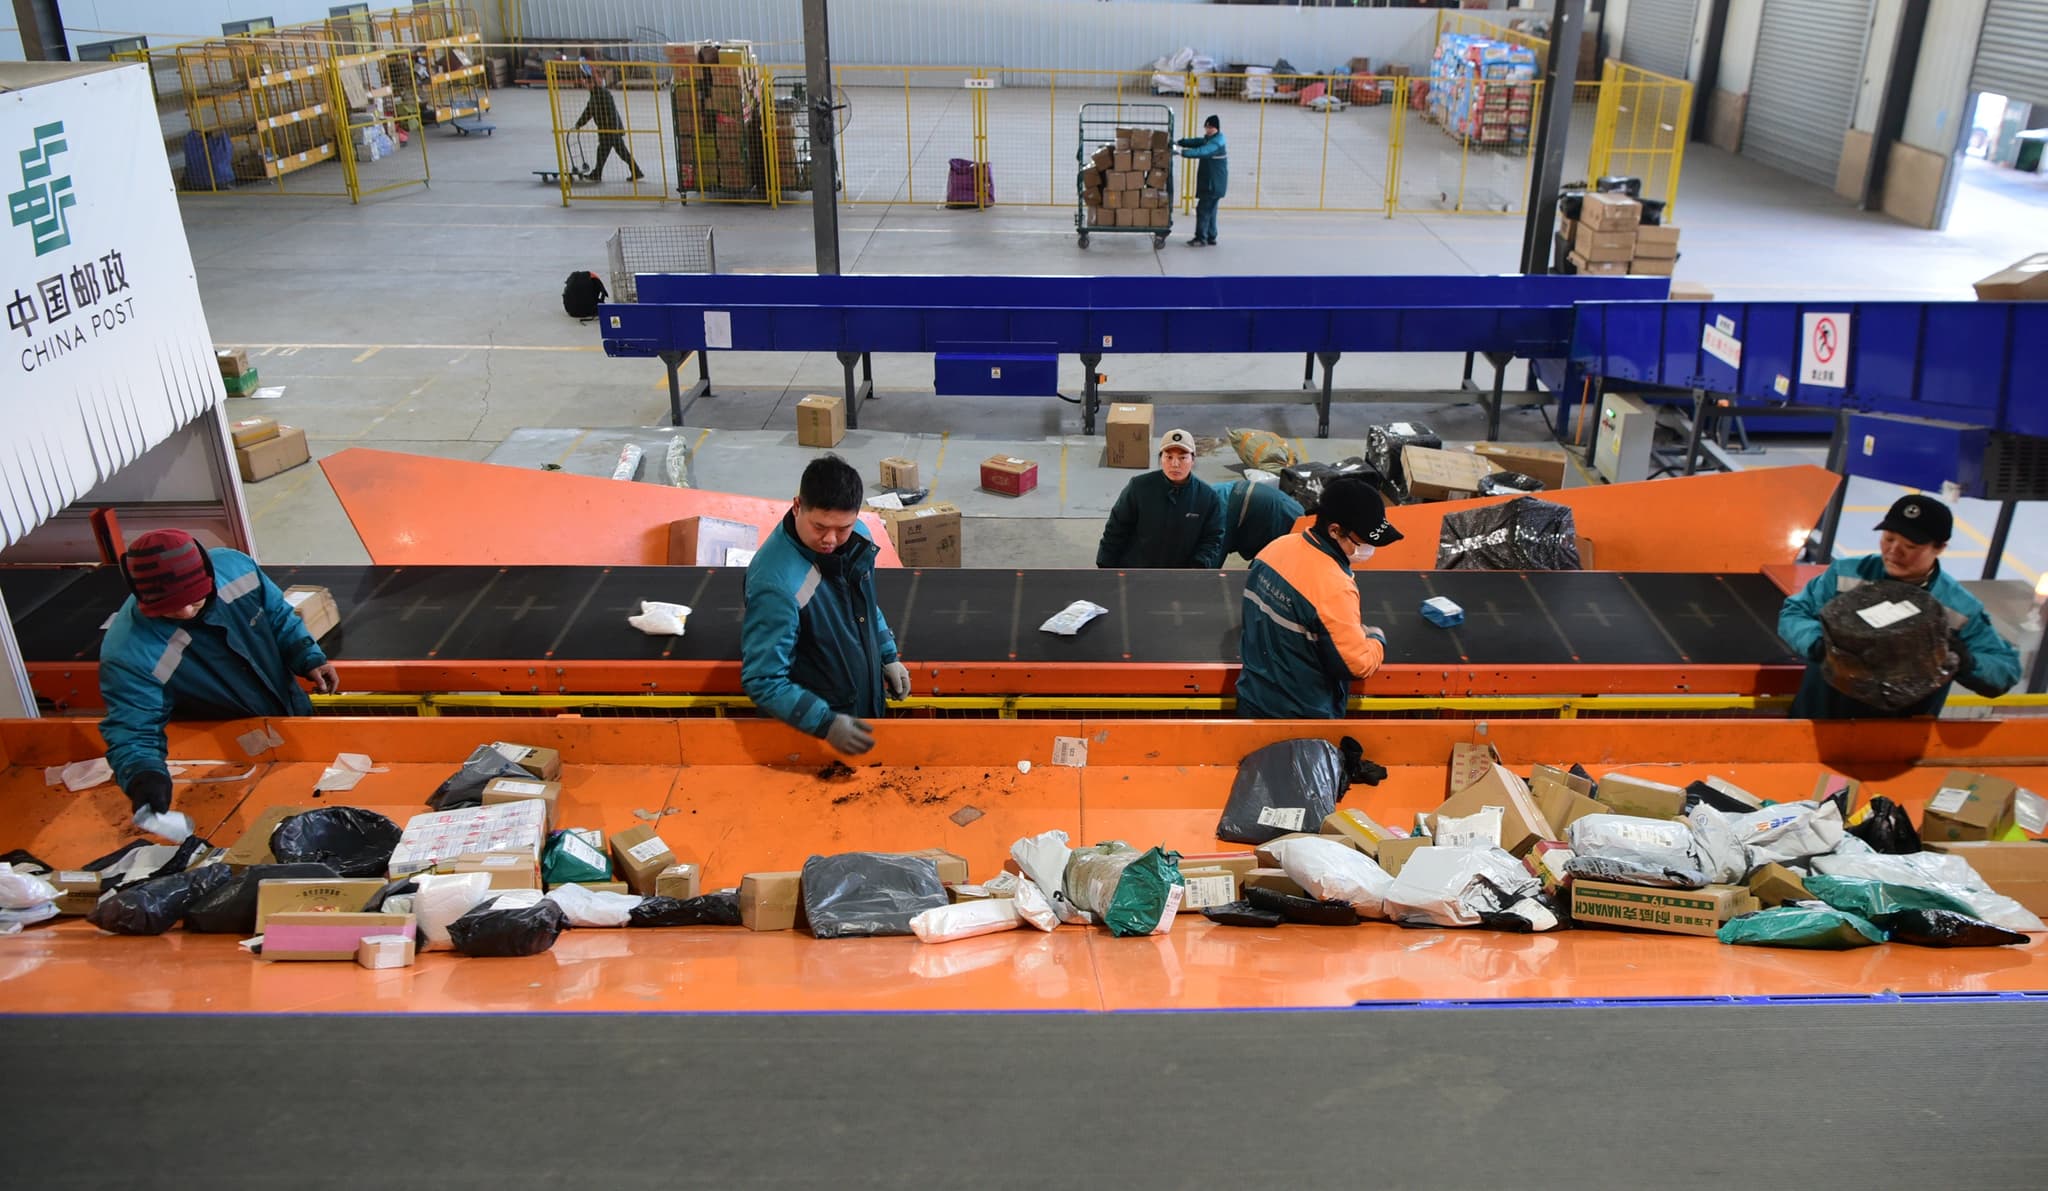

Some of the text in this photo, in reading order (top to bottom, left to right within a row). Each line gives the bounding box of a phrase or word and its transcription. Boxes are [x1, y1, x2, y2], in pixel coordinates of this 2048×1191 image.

[6, 248, 130, 338] 中国邮政
[21, 297, 135, 372] CHINA POST
[1575, 900, 1622, 919] NAVARCH
[1622, 906, 1670, 925] 耐威克
